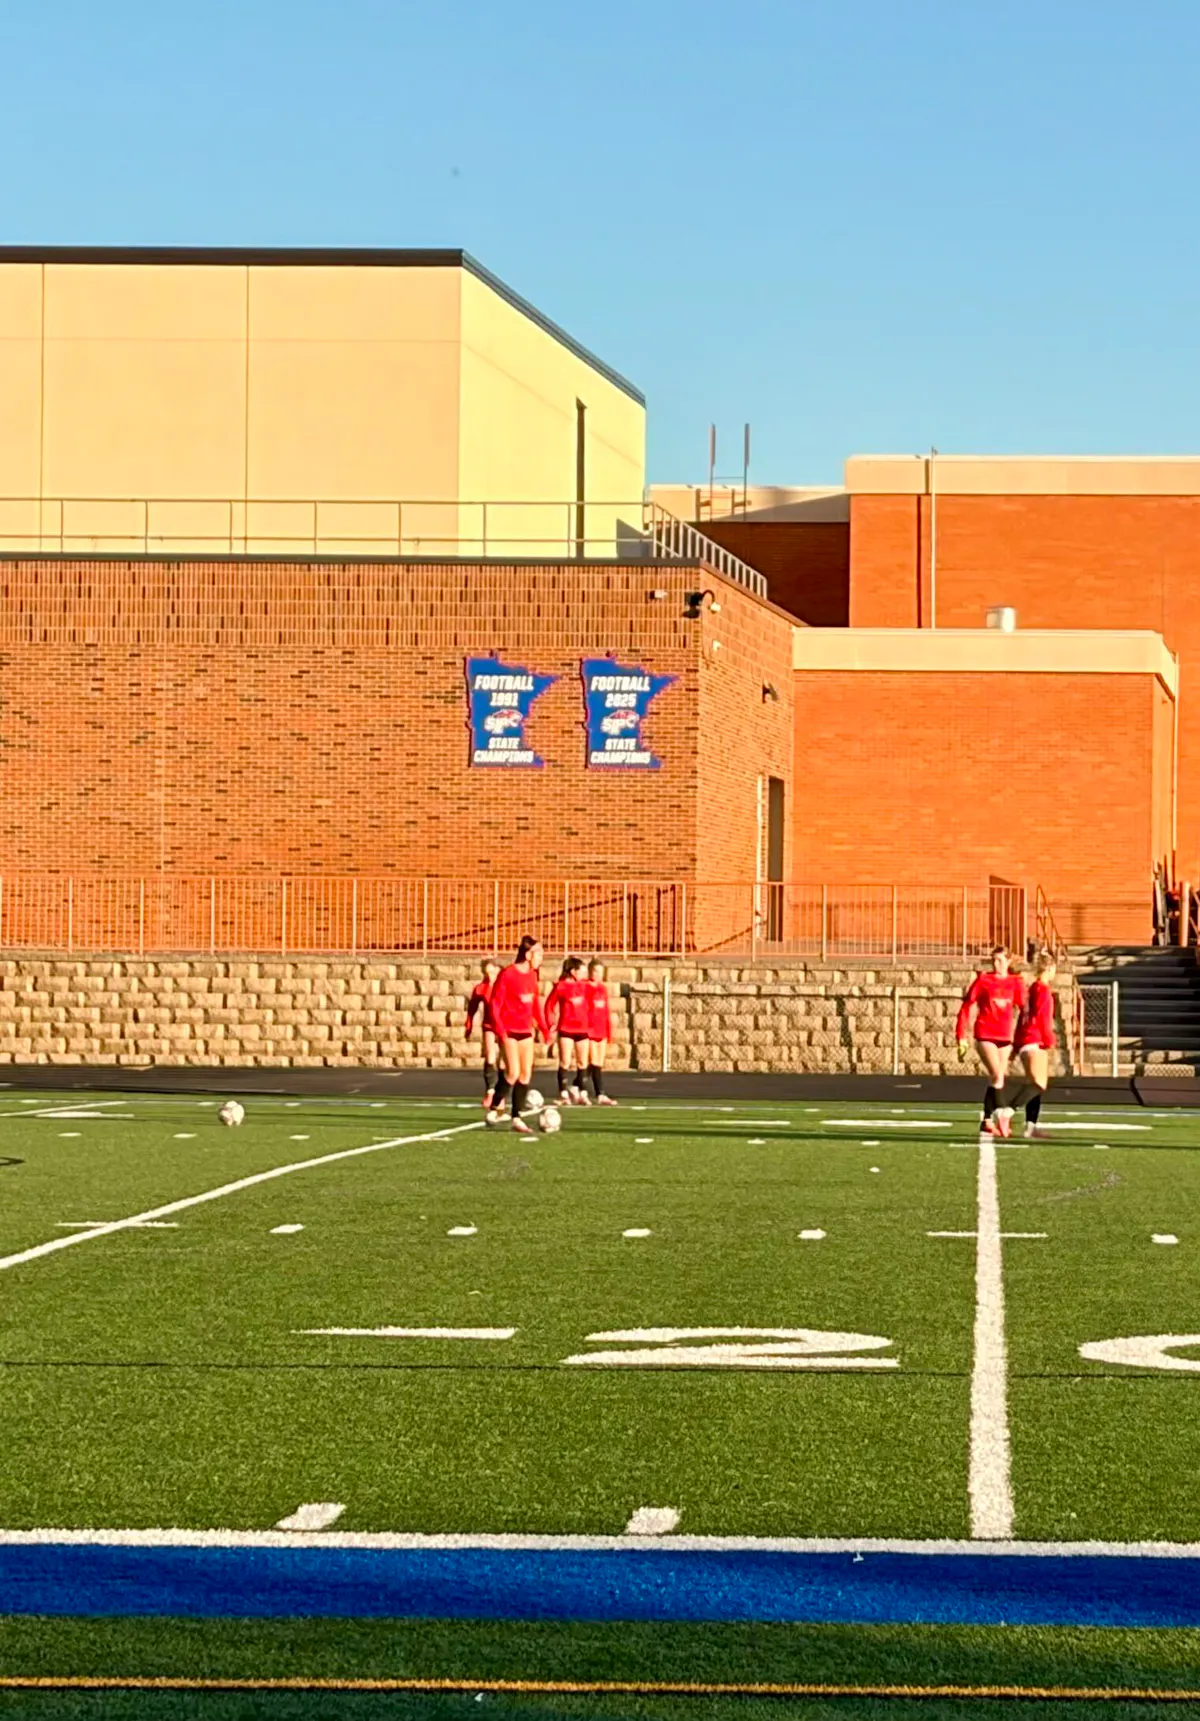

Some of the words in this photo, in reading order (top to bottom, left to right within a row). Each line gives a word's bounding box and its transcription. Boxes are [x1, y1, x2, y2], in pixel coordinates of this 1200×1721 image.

[474, 675, 534, 691] FOOTBALL
[590, 676, 651, 691] FOOTBALL
[488, 737, 520, 749] STATE
[605, 738, 636, 750] STATE
[473, 750, 534, 763] CHAMPIONS
[590, 752, 651, 764] CHAMPIONS
